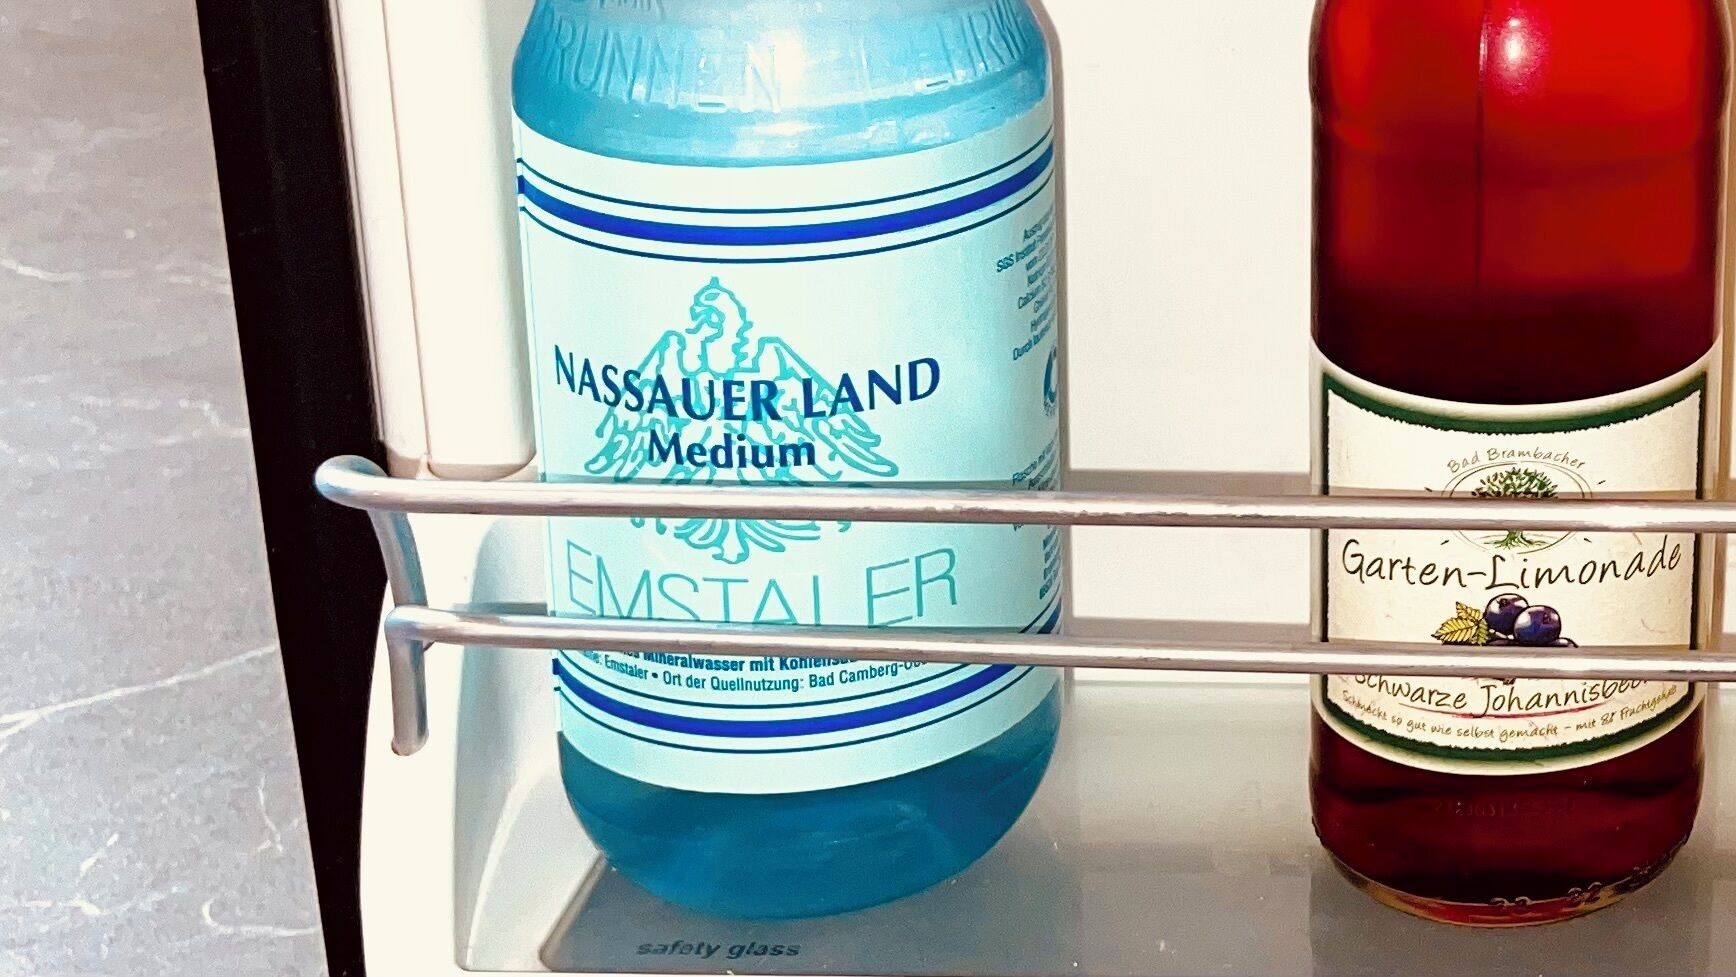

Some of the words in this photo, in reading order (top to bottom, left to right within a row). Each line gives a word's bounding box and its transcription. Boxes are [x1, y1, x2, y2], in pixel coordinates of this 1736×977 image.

[554, 344, 782, 421] NASSAUER
[802, 357, 942, 420] LAND
[647, 432, 817, 470] Medium
[1446, 450, 1480, 473] Bad
[1486, 446, 1586, 470] Brambacher
[1340, 534, 1682, 591] Garten-Limonade
[604, 653, 649, 681] Emstaler
[662, 670, 682, 687] Ort
[685, 674, 707, 690] der
[710, 676, 804, 693] Quellnutzung:
[808, 671, 835, 688] Bad
[749, 656, 775, 672] mit
[1405, 719, 1428, 734] gut
[1430, 724, 1453, 736] wie
[1455, 726, 1495, 739] selbst
[635, 939, 722, 960] safety
[726, 940, 802, 960] glass
